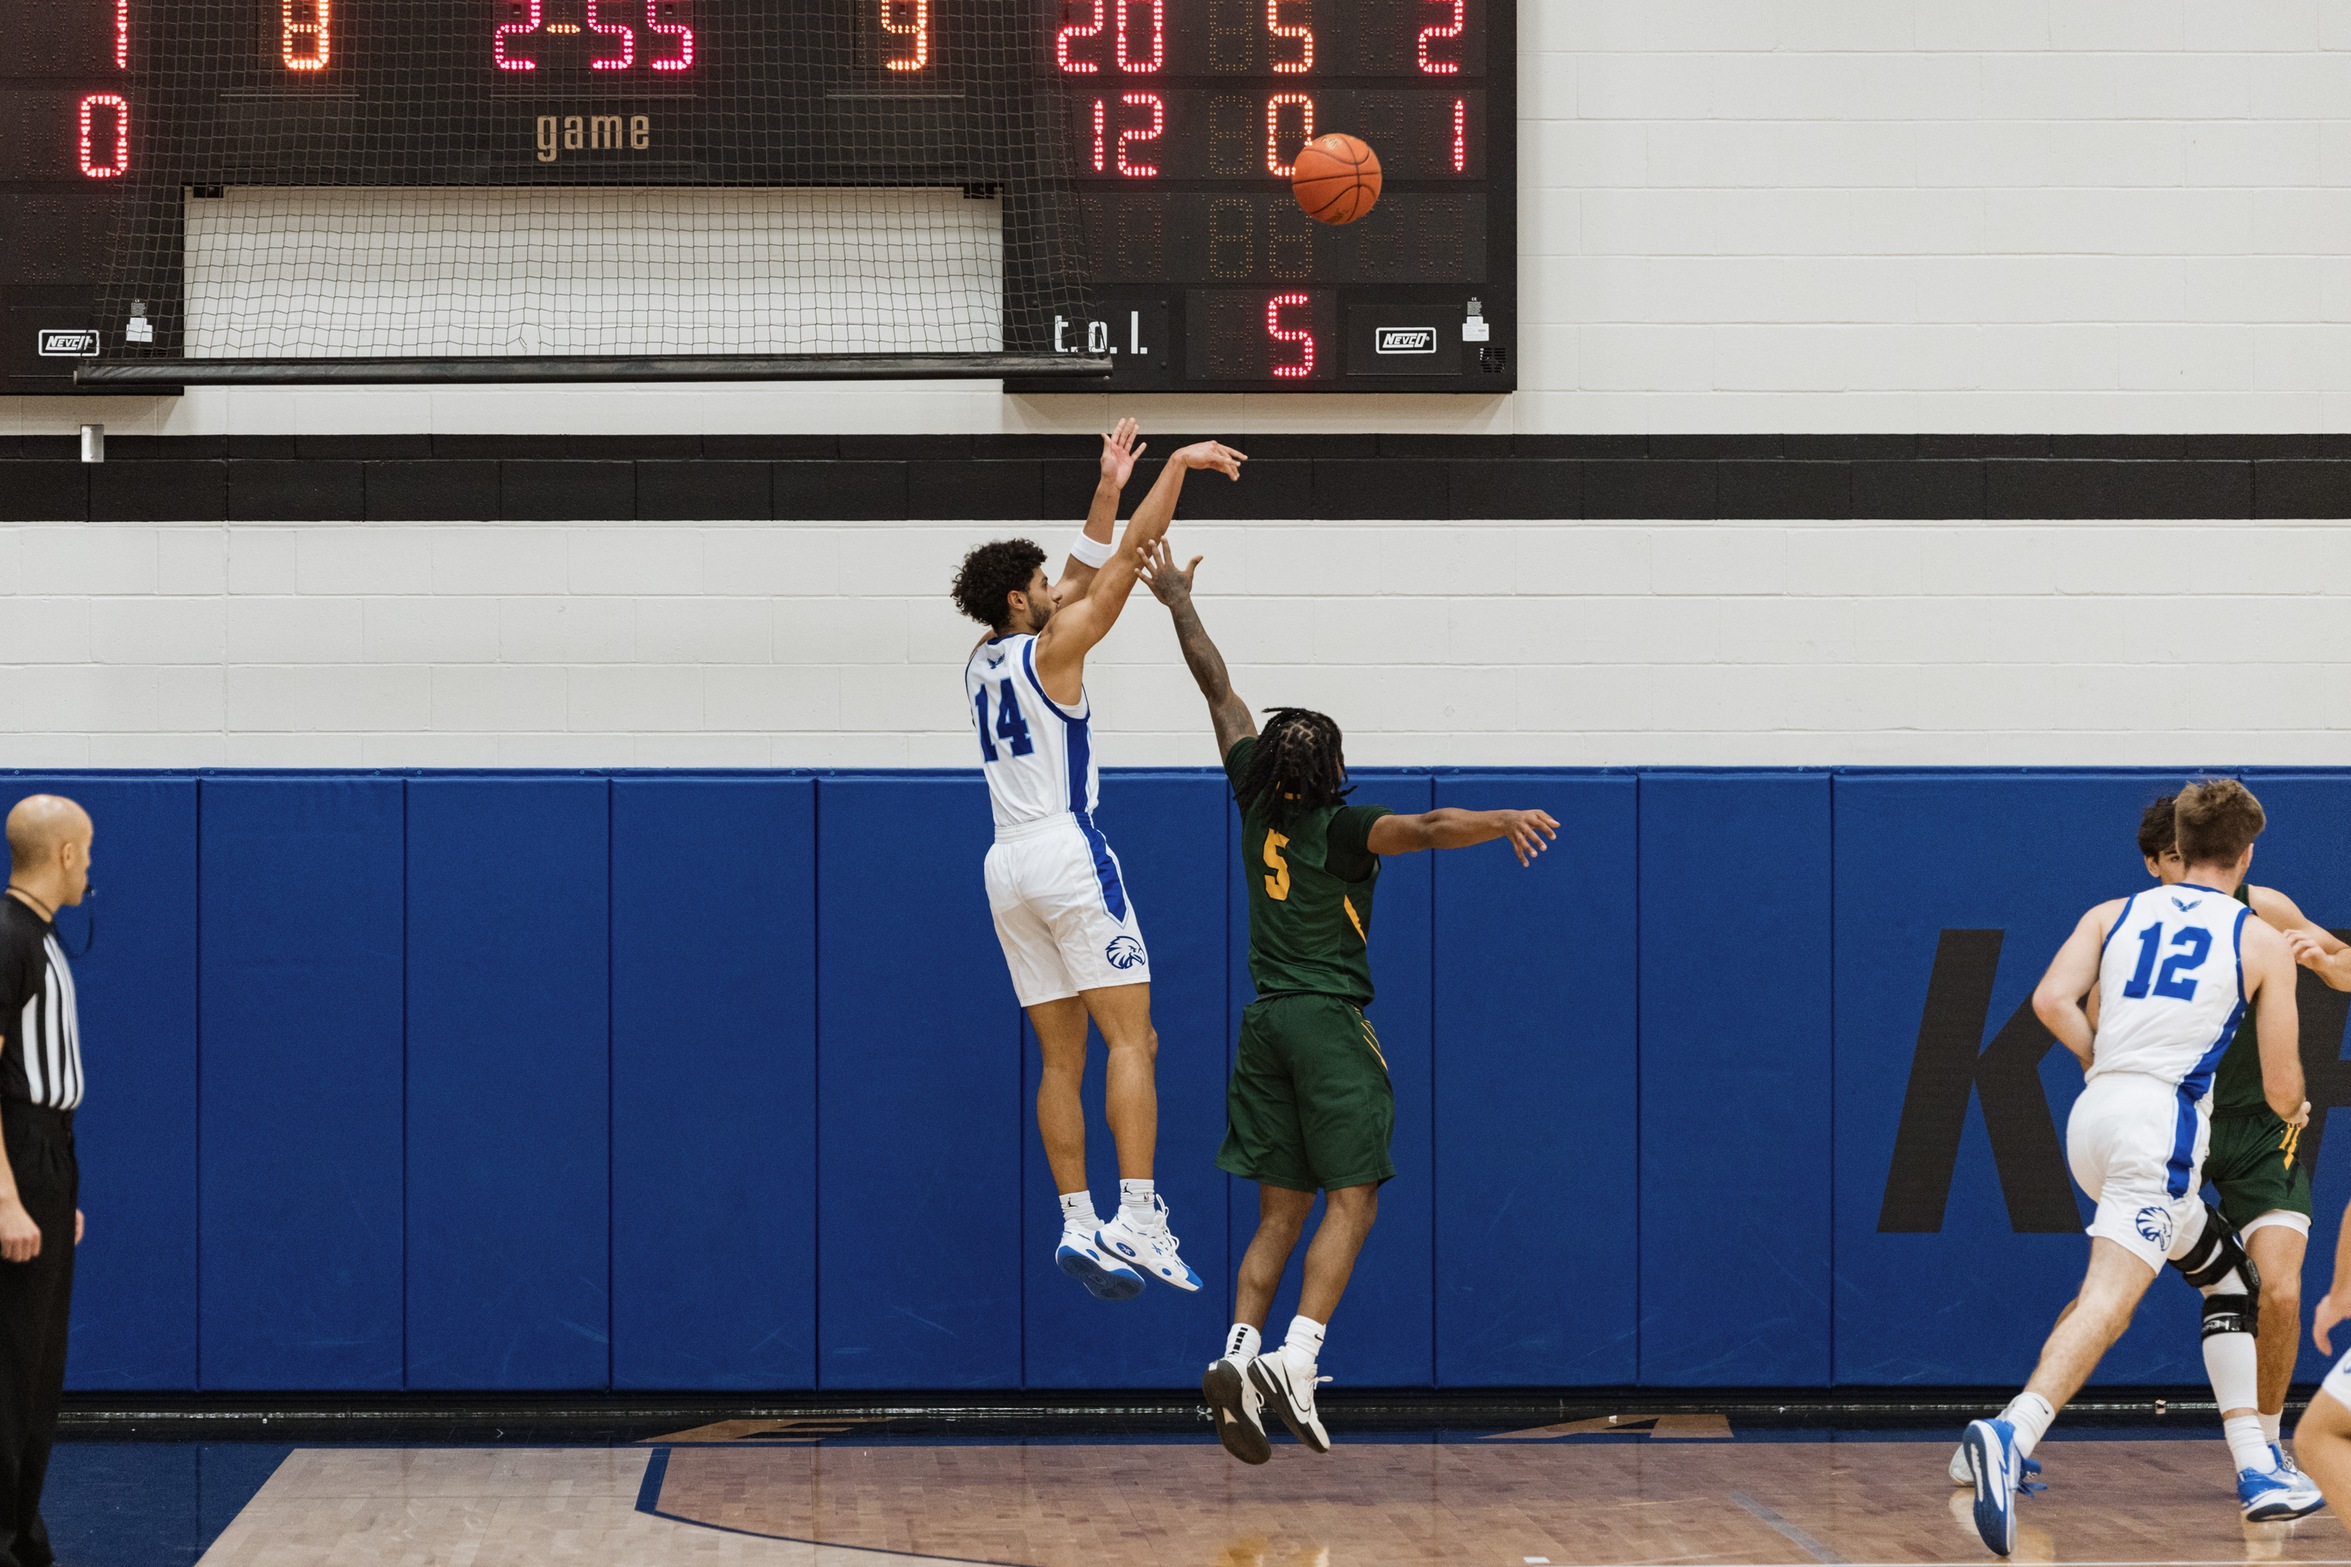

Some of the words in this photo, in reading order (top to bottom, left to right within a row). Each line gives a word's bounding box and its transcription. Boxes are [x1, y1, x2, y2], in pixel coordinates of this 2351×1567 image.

[282, 0, 330, 69] 8
[1057, 0, 1162, 73] 20
[1268, 0, 1313, 73] 5
[1418, 0, 1463, 73] 2
[80, 94, 128, 177] 0
[536, 114, 650, 162] game
[1094, 95, 1162, 176] 12
[1267, 94, 1313, 176] 0
[1454, 100, 1463, 172] 1
[1054, 310, 1148, 354] t.o.l.
[1268, 295, 1313, 376] 5
[1382, 332, 1429, 348] NEVCO
[975, 677, 1035, 763] 14
[1263, 827, 1291, 901] 5
[2123, 922, 2213, 1001] 12
